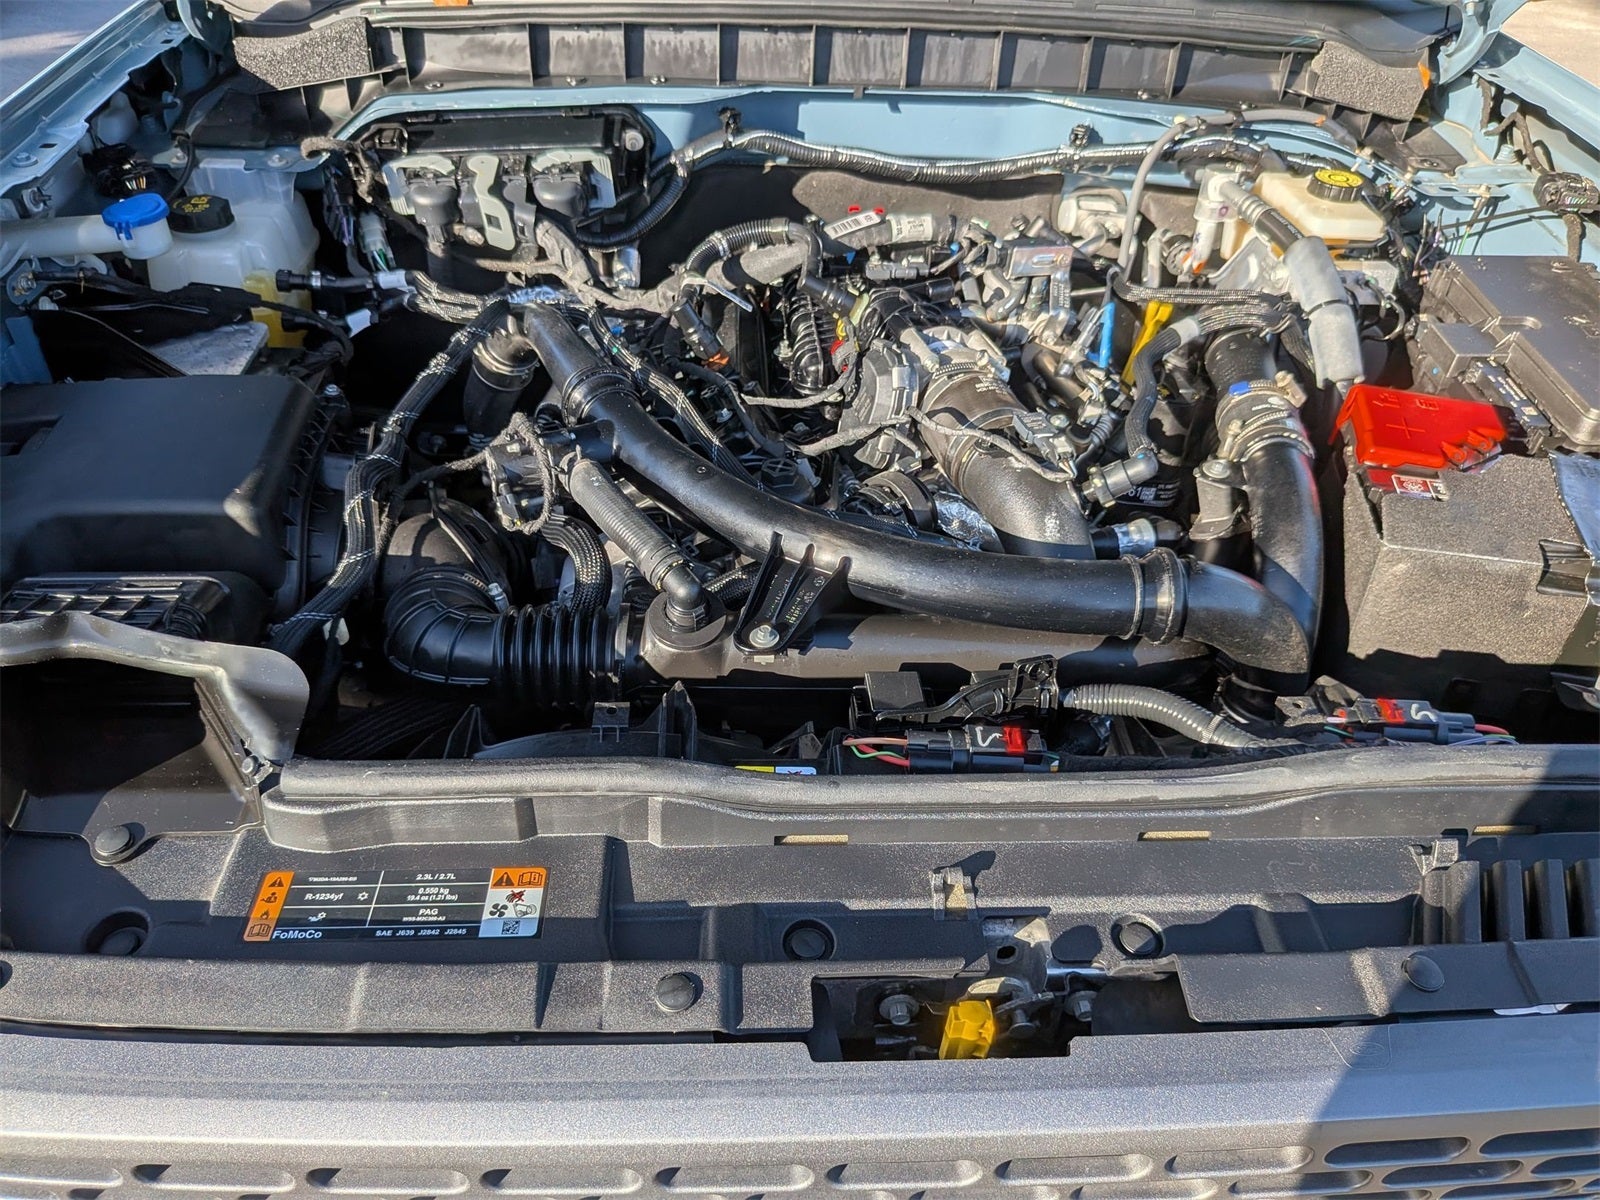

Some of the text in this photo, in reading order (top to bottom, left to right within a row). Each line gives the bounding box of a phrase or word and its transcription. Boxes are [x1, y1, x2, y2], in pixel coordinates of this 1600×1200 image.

[415, 873, 434, 881] 2.3L
[438, 873, 456, 881] 2.7L
[417, 887, 450, 896] 0.550 kg
[303, 892, 344, 902] R-1234yf
[418, 908, 439, 916] PAG
[272, 930, 322, 940] FoMoCo
[417, 928, 441, 936] J2842
